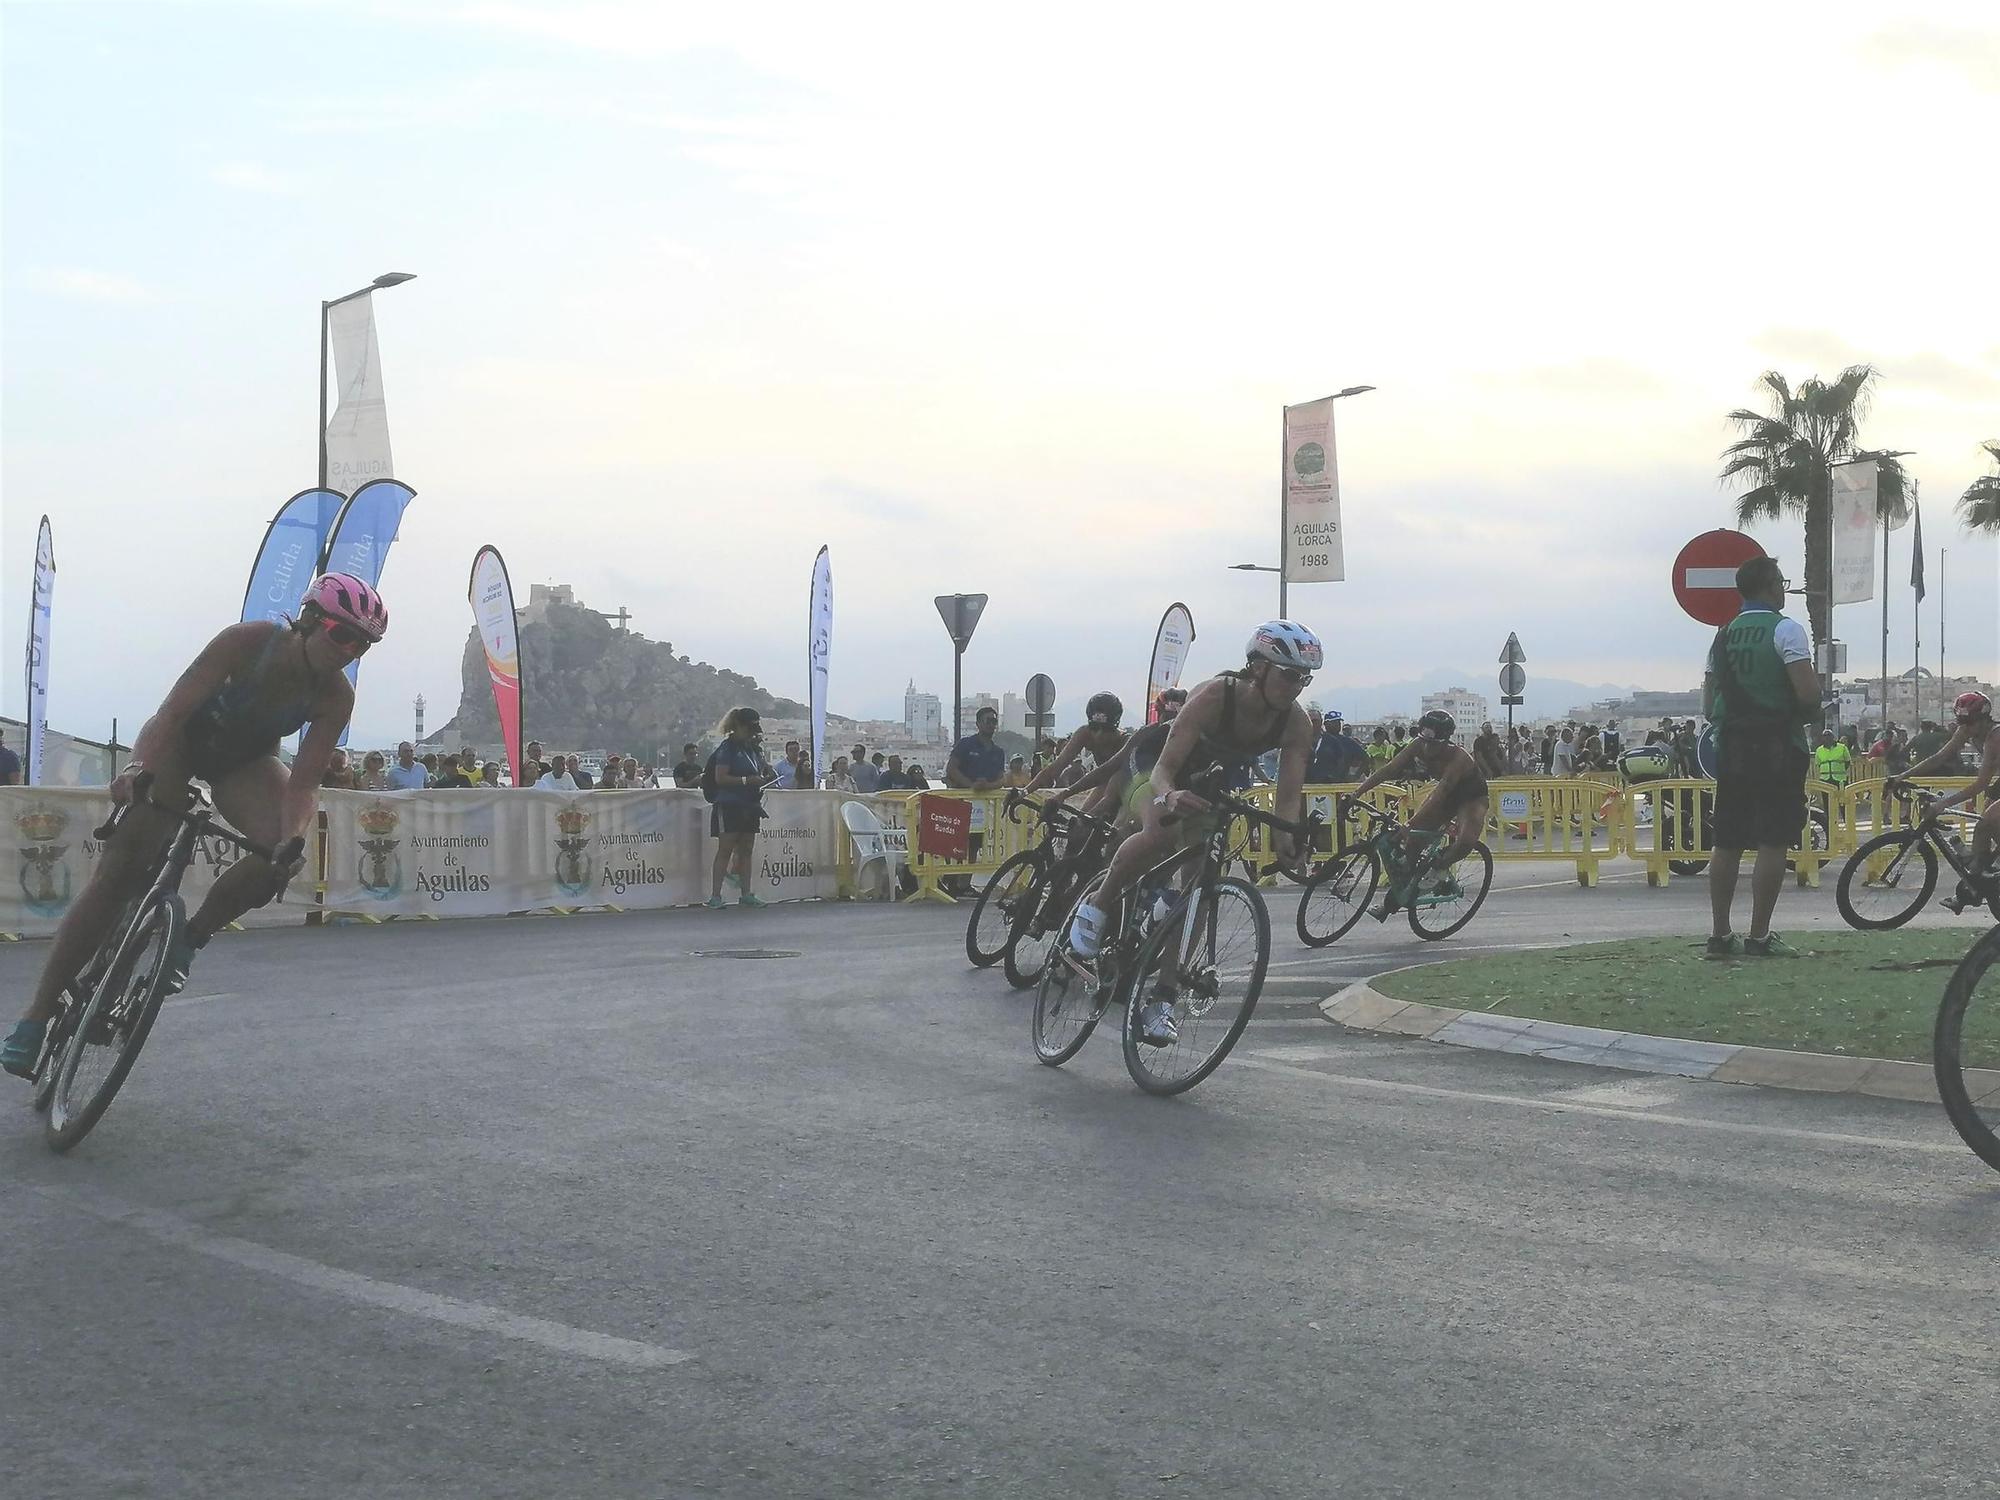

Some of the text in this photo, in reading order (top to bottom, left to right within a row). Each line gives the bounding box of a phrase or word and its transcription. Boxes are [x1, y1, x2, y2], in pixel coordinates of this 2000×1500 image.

[1298, 536, 1332, 546] LORCA
[1301, 554, 1329, 567] 1988
[267, 543, 301, 602] Cálida
[953, 816, 961, 825] de
[411, 834, 489, 852] Ayuntamiento
[599, 831, 664, 850] Ayuntamiento
[760, 827, 816, 843] Ayuntamiento
[626, 848, 638, 861] de
[782, 842, 794, 854] de
[444, 852, 458, 866] de
[602, 860, 665, 895] Águilas
[760, 854, 814, 886] Águilas
[416, 866, 490, 901] Águilas
